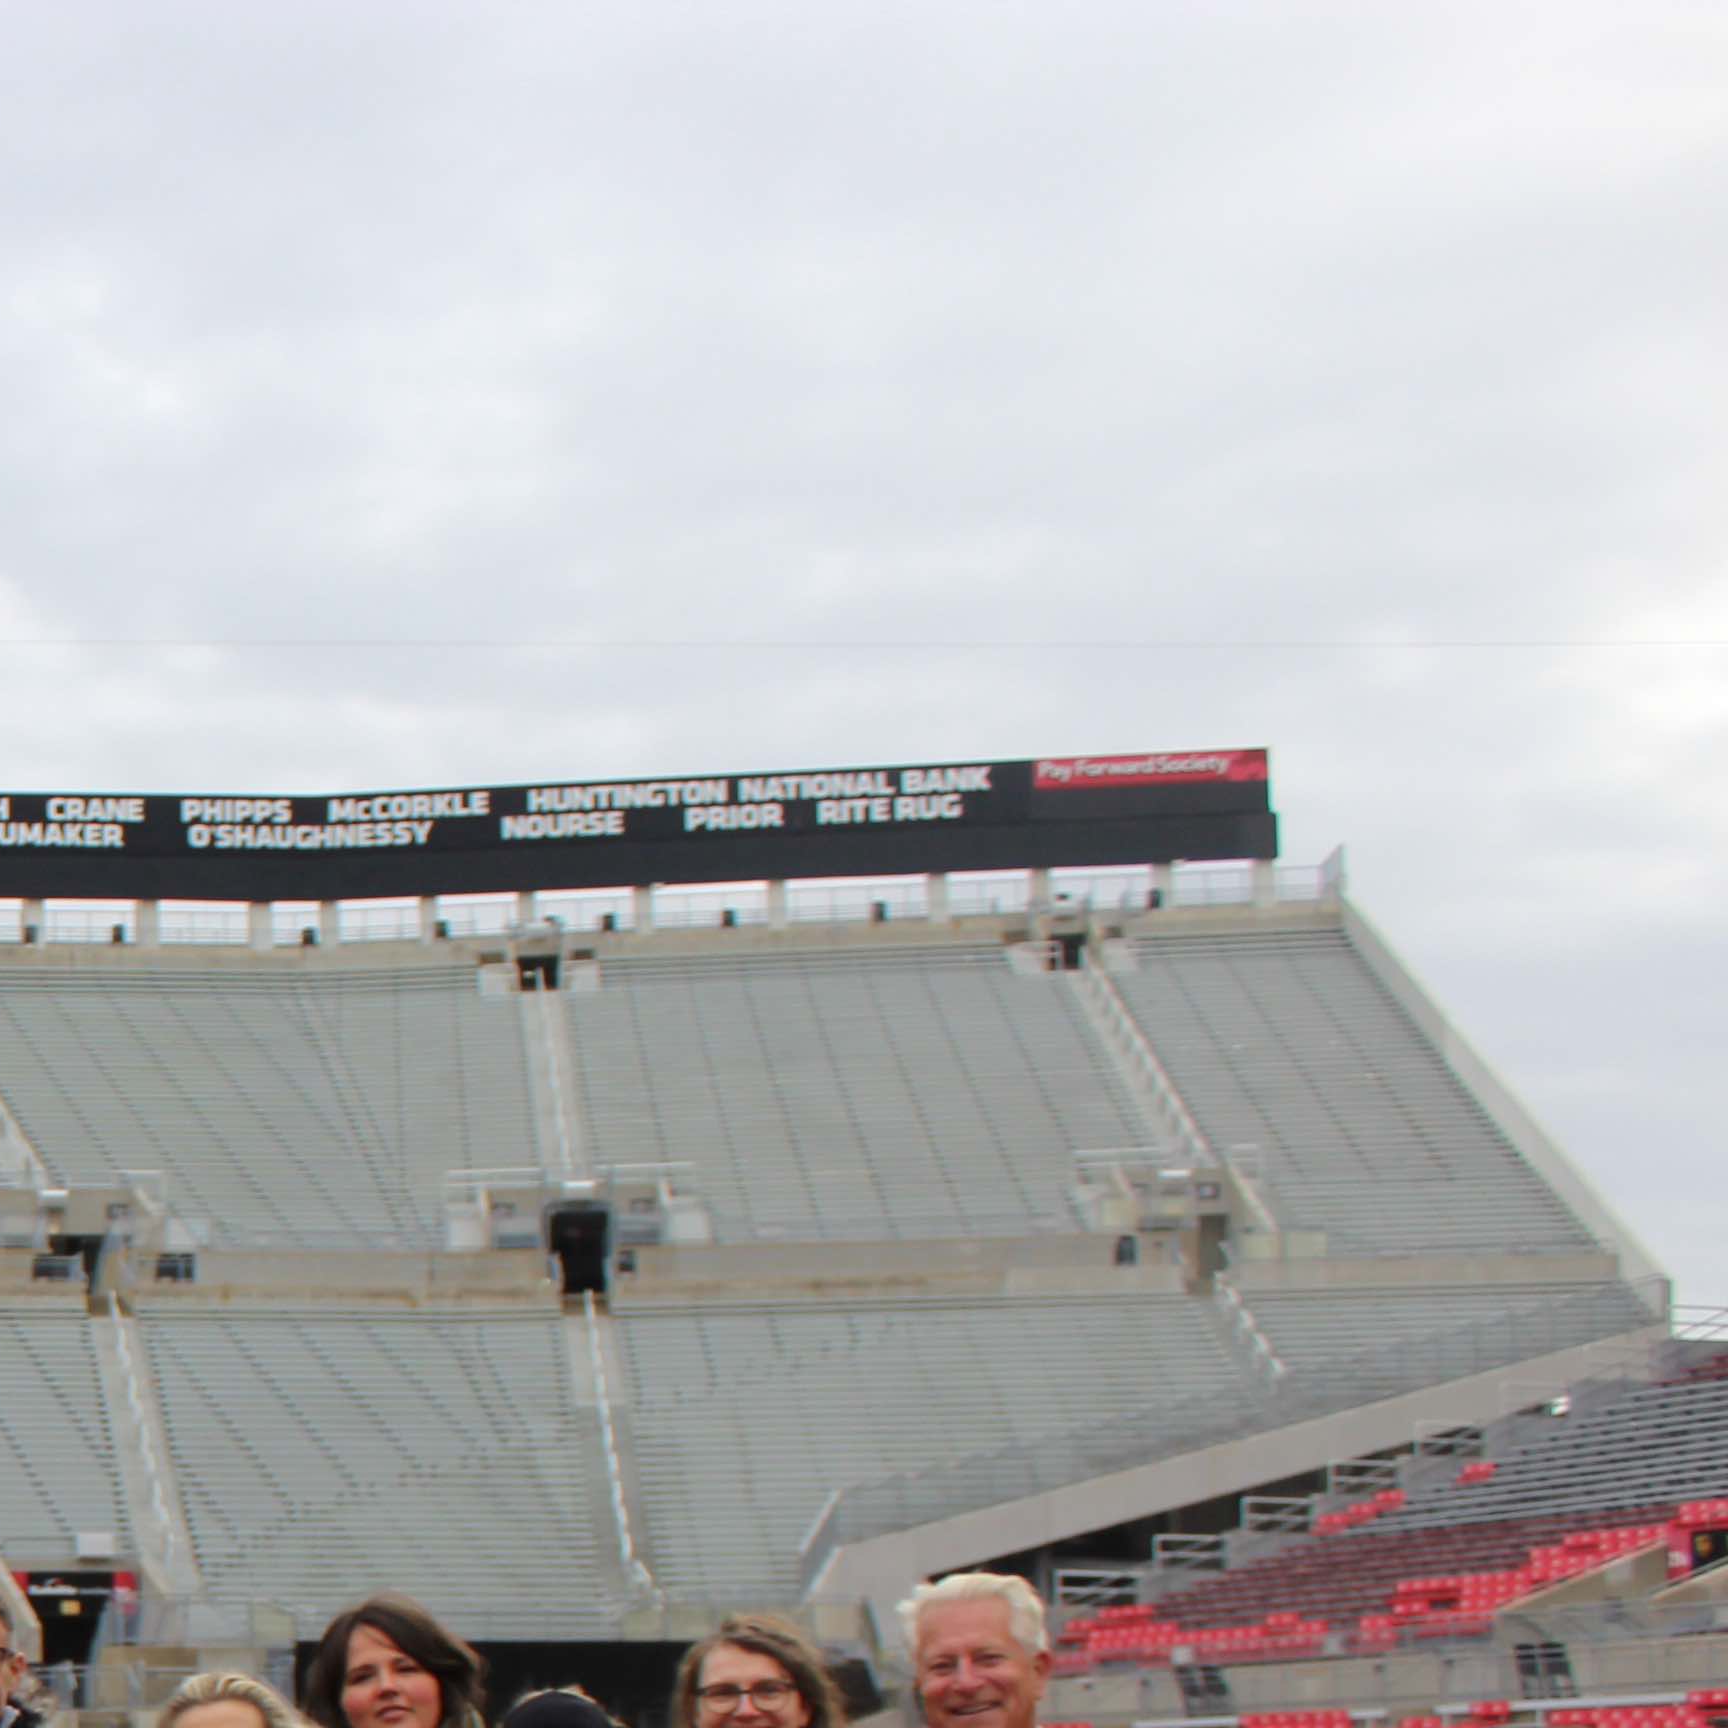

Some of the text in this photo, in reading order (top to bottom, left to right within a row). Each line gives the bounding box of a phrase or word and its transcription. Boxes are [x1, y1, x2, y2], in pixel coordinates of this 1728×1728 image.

[1038, 755, 1231, 783] Pay Forward Society
[527, 766, 991, 812] HUNTINGTON NATIONAL BANK
[46, 797, 144, 822] CRANE
[180, 798, 292, 824] PHIPPS
[327, 791, 490, 823] McCORKLE
[683, 803, 784, 832] PRIOR
[817, 795, 963, 825] RITE RUG
[187, 821, 433, 849] O'SHAUGHNESSY
[501, 811, 625, 841] NOURSE
